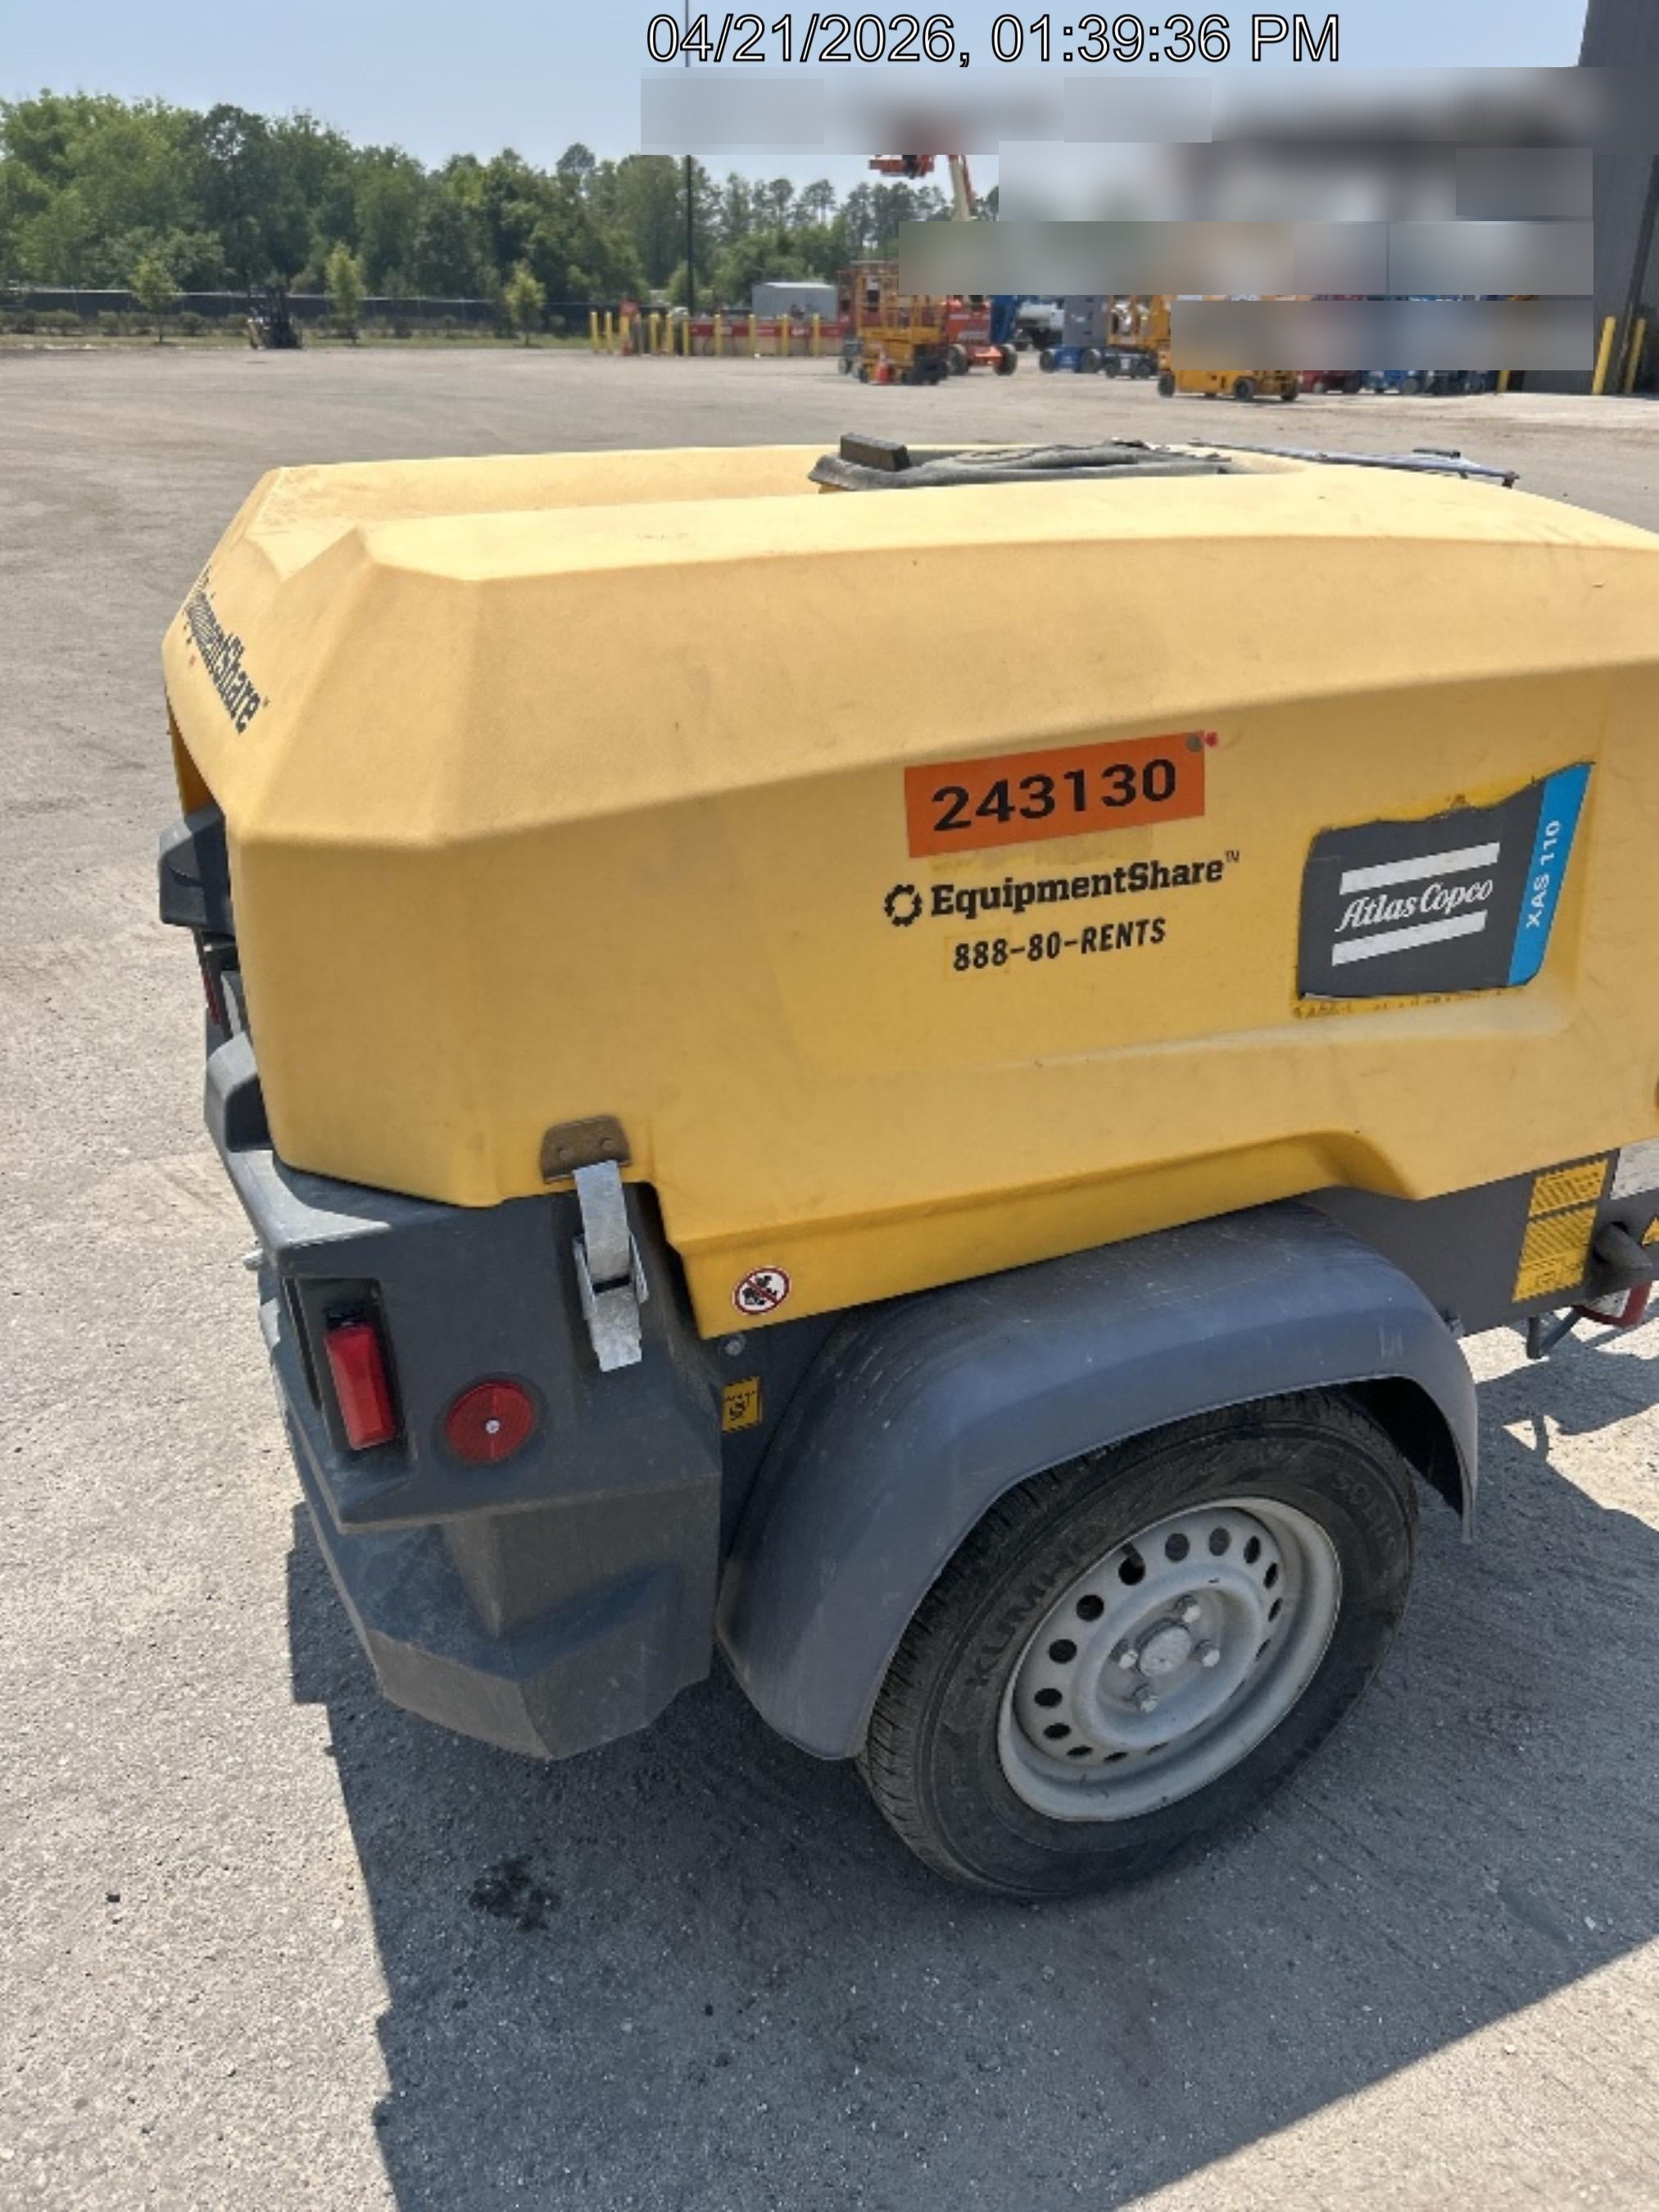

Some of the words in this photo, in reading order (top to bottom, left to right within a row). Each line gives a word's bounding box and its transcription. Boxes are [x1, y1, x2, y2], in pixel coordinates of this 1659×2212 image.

[931, 758, 1176, 832] 243130
[1335, 894, 1417, 932] Atlas
[1420, 879, 1494, 915] Copco
[1525, 874, 1549, 928] XAS
[1540, 821, 1560, 866] 110
[953, 918, 1166, 972] 888-80-RENTS
